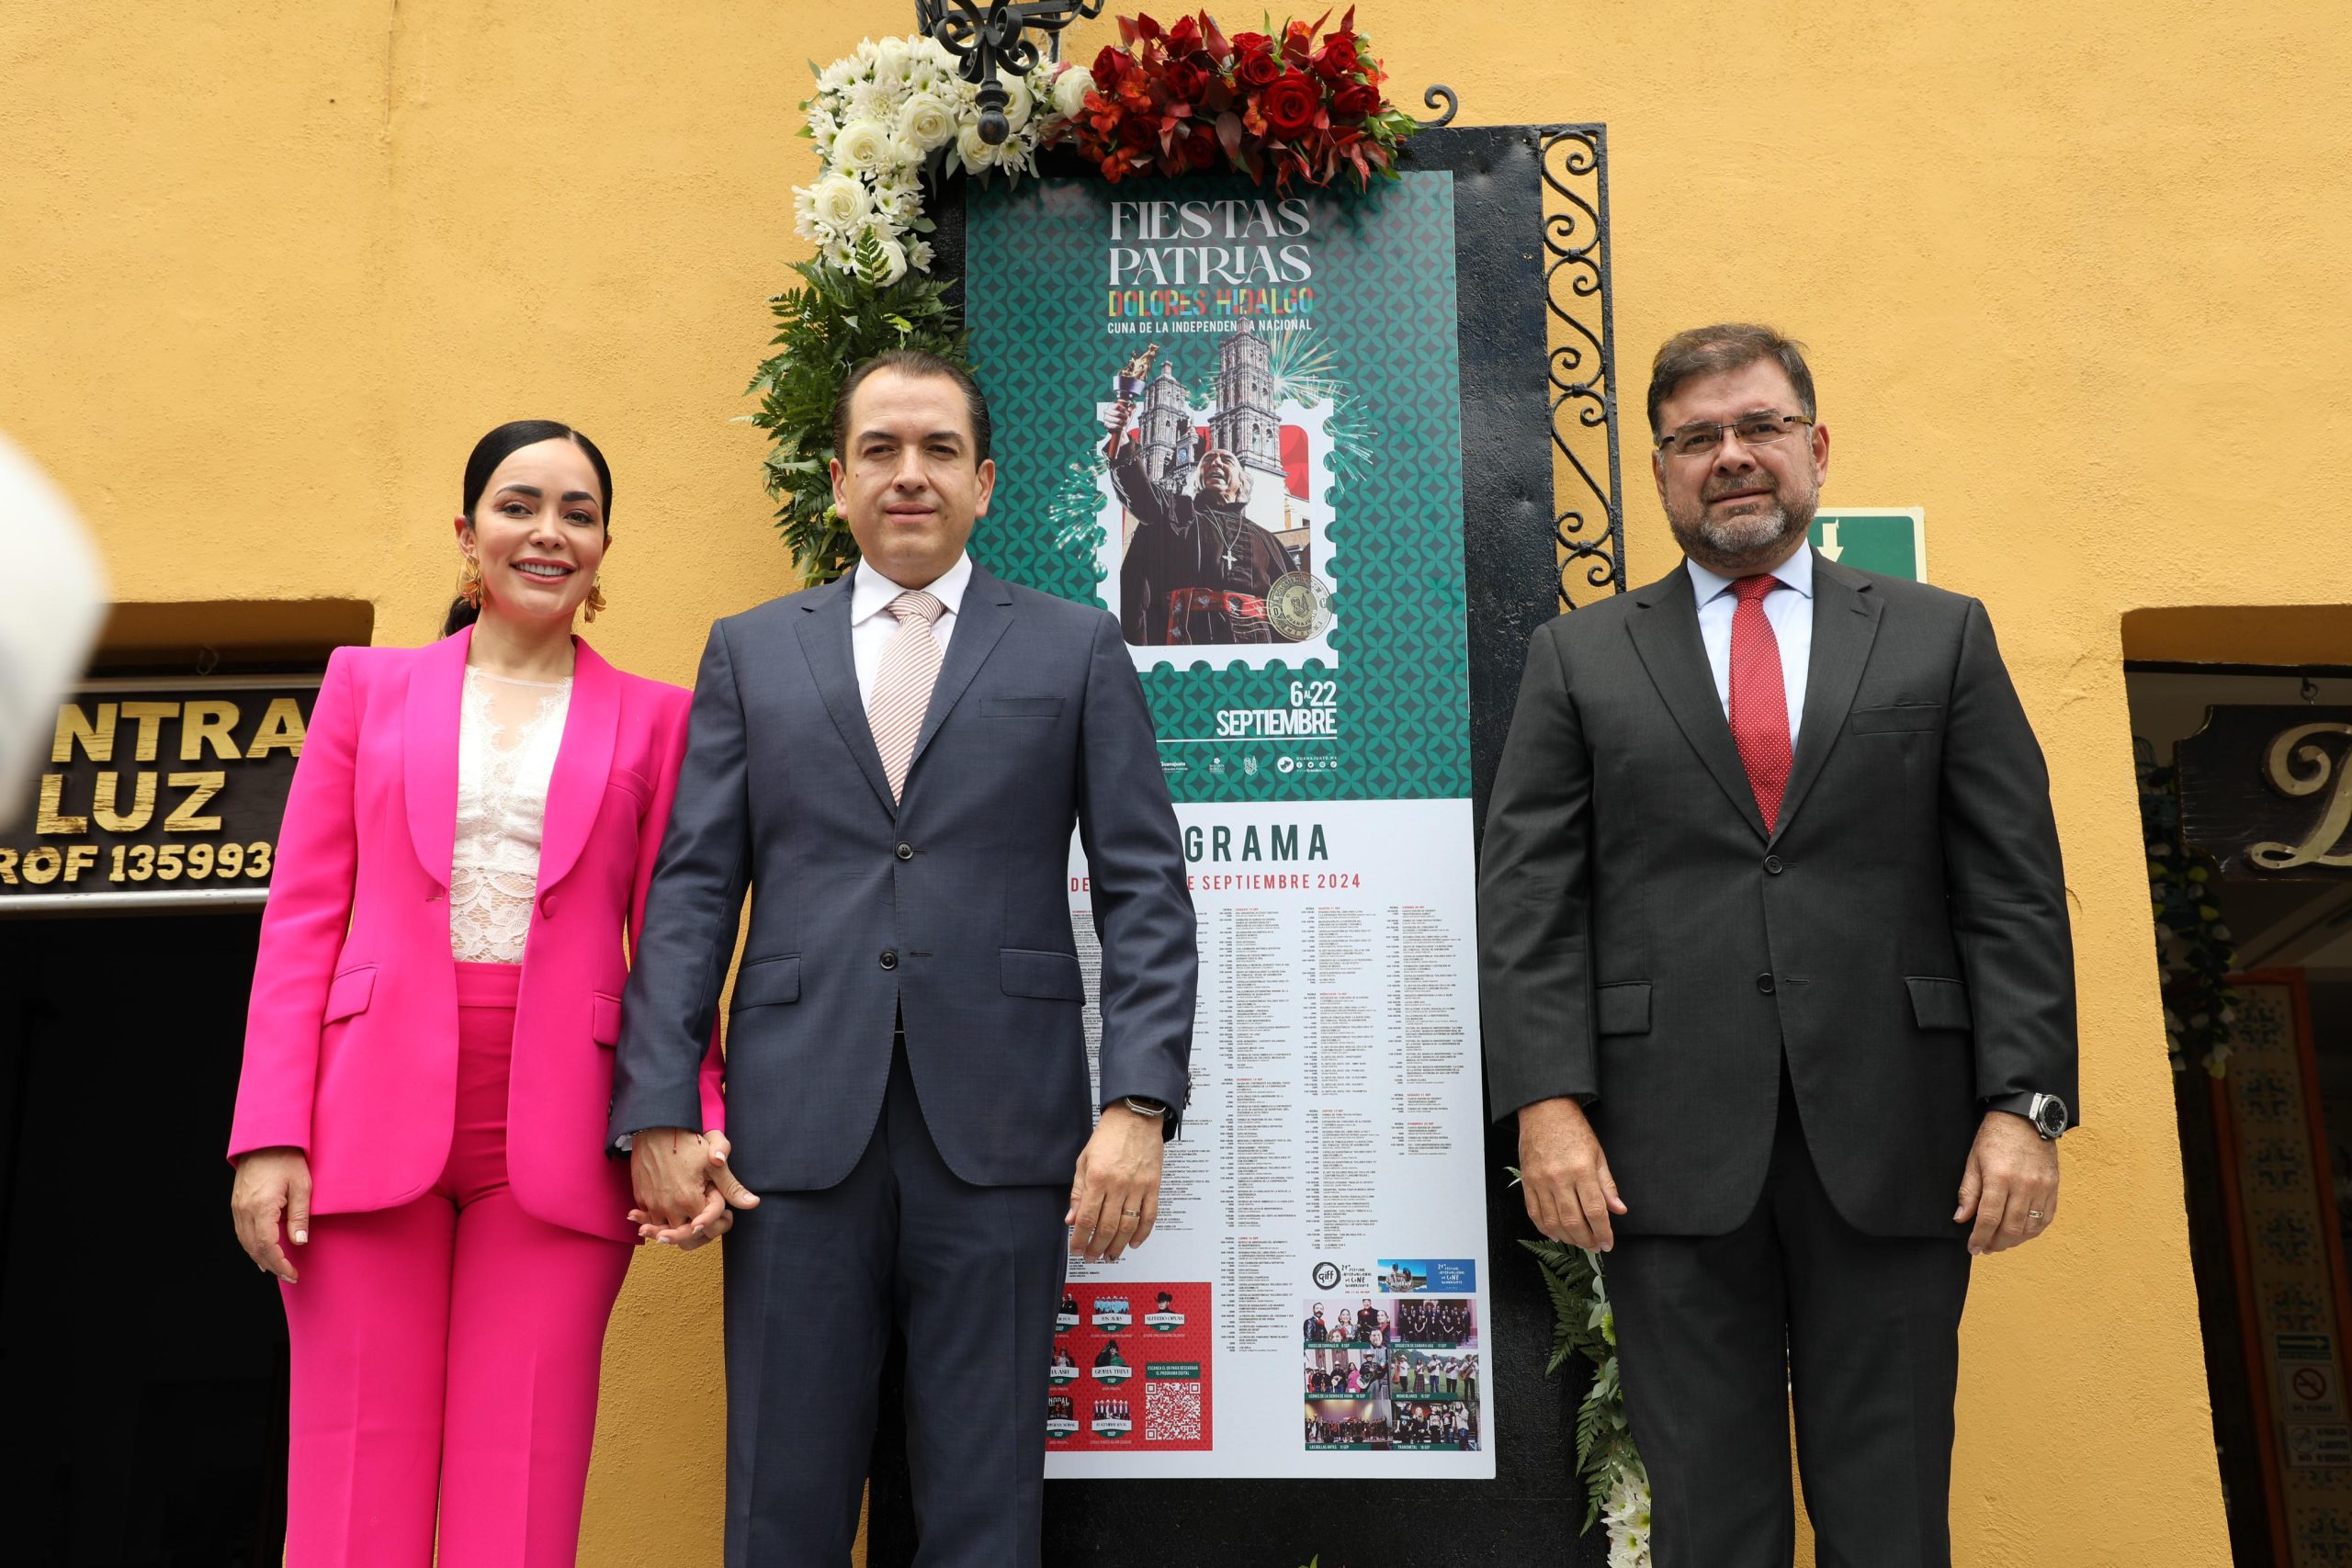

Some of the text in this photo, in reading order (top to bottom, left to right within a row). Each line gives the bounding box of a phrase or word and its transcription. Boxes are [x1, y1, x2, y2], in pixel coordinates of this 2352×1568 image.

[1111, 198, 1310, 240] FIESTAS
[1109, 244, 1312, 286] PATRIAS
[1108, 287, 1314, 317] DOLORES HIDALGO
[1107, 319, 1312, 333] CUNA DE LA INDEPENDENA NACIONAL
[1290, 681, 1303, 706] 6
[1310, 681, 1337, 706] 22
[1216, 708, 1338, 736] SEPTIEMBRE
[36, 772, 225, 835] LUZ
[1184, 824, 1329, 863] GRAMA
[109, 841, 277, 882] 135993
[1203, 874, 1309, 890] SEPTIEMBRE
[1317, 874, 1361, 888] 2024
